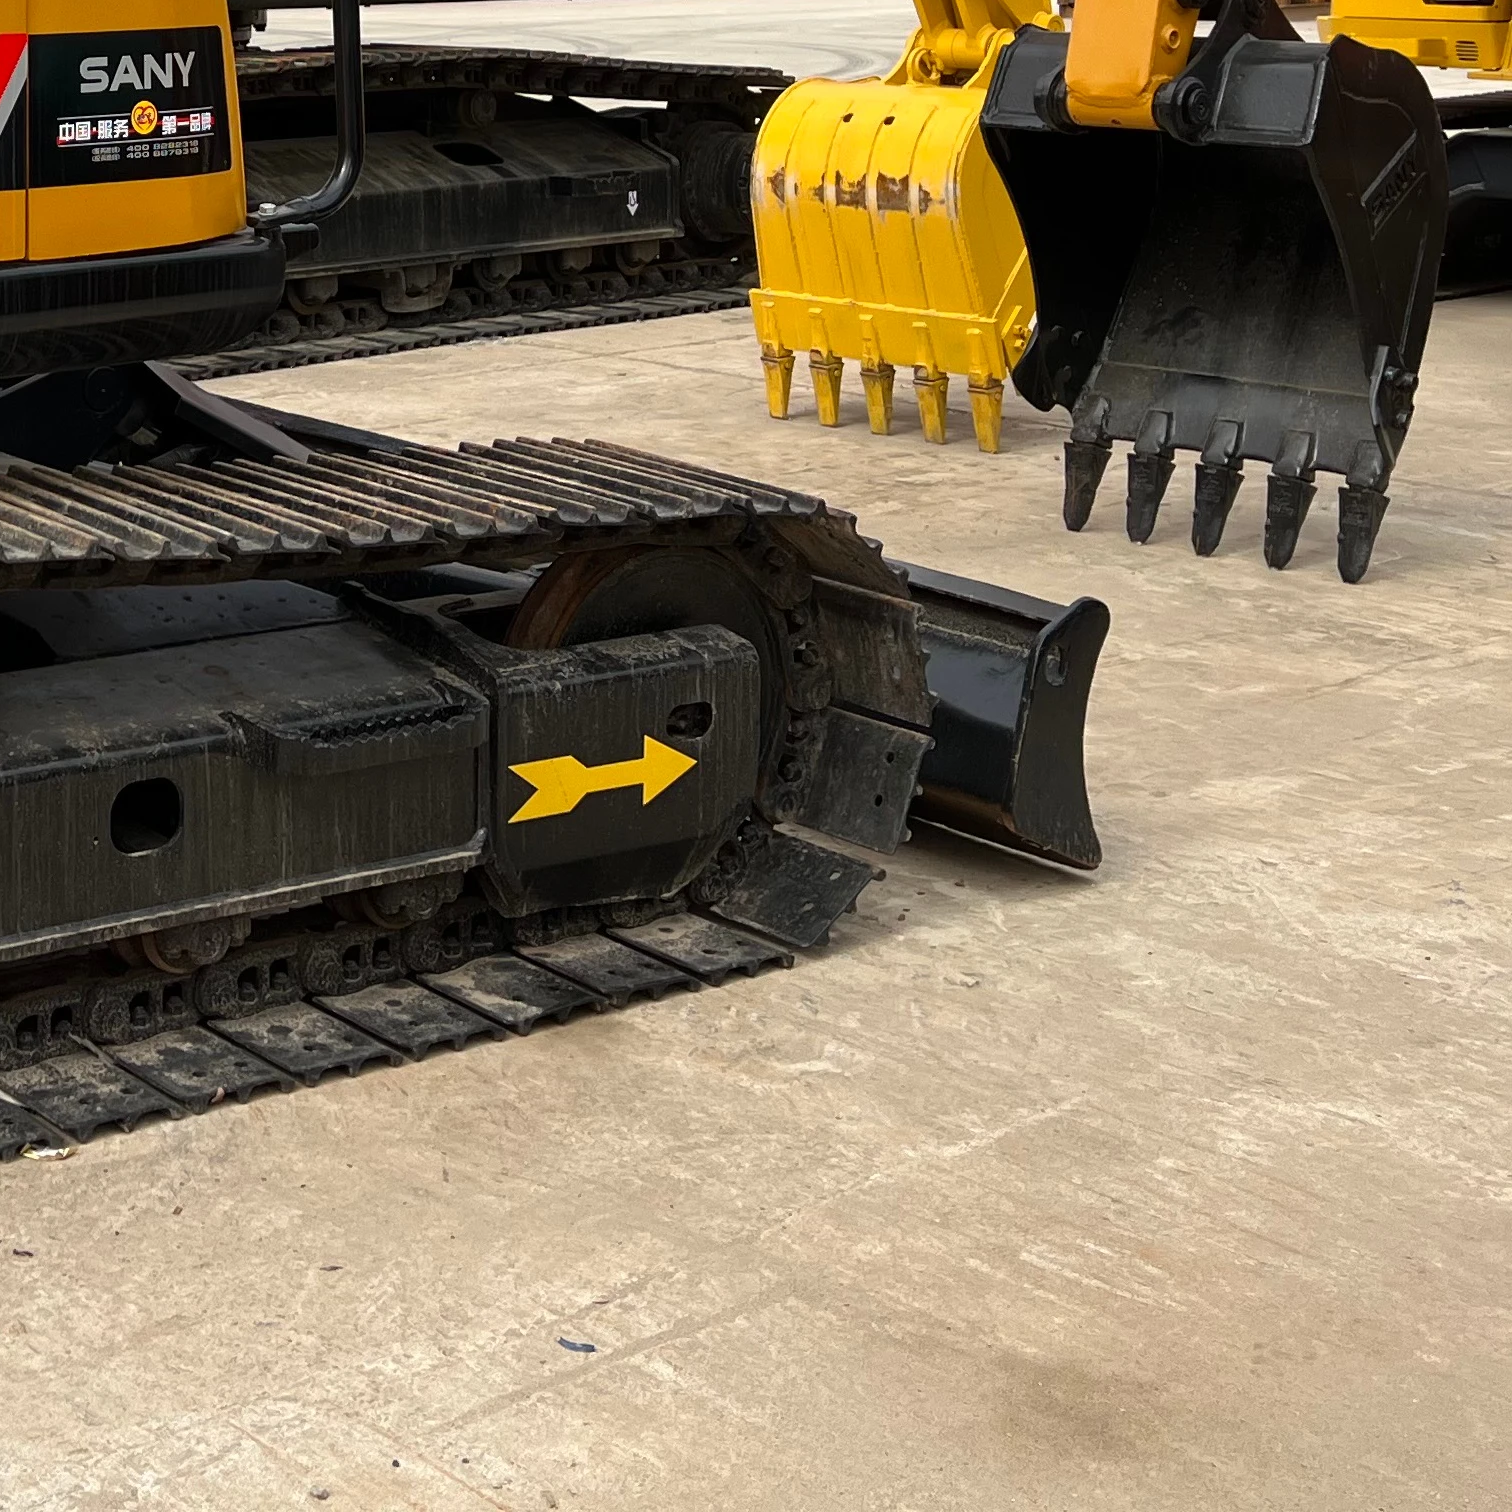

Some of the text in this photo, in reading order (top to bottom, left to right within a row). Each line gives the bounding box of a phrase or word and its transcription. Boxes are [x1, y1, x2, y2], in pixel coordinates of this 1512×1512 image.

[79, 51, 196, 94] SANY
[126, 143, 150, 152] 400
[126, 151, 150, 159] 400
